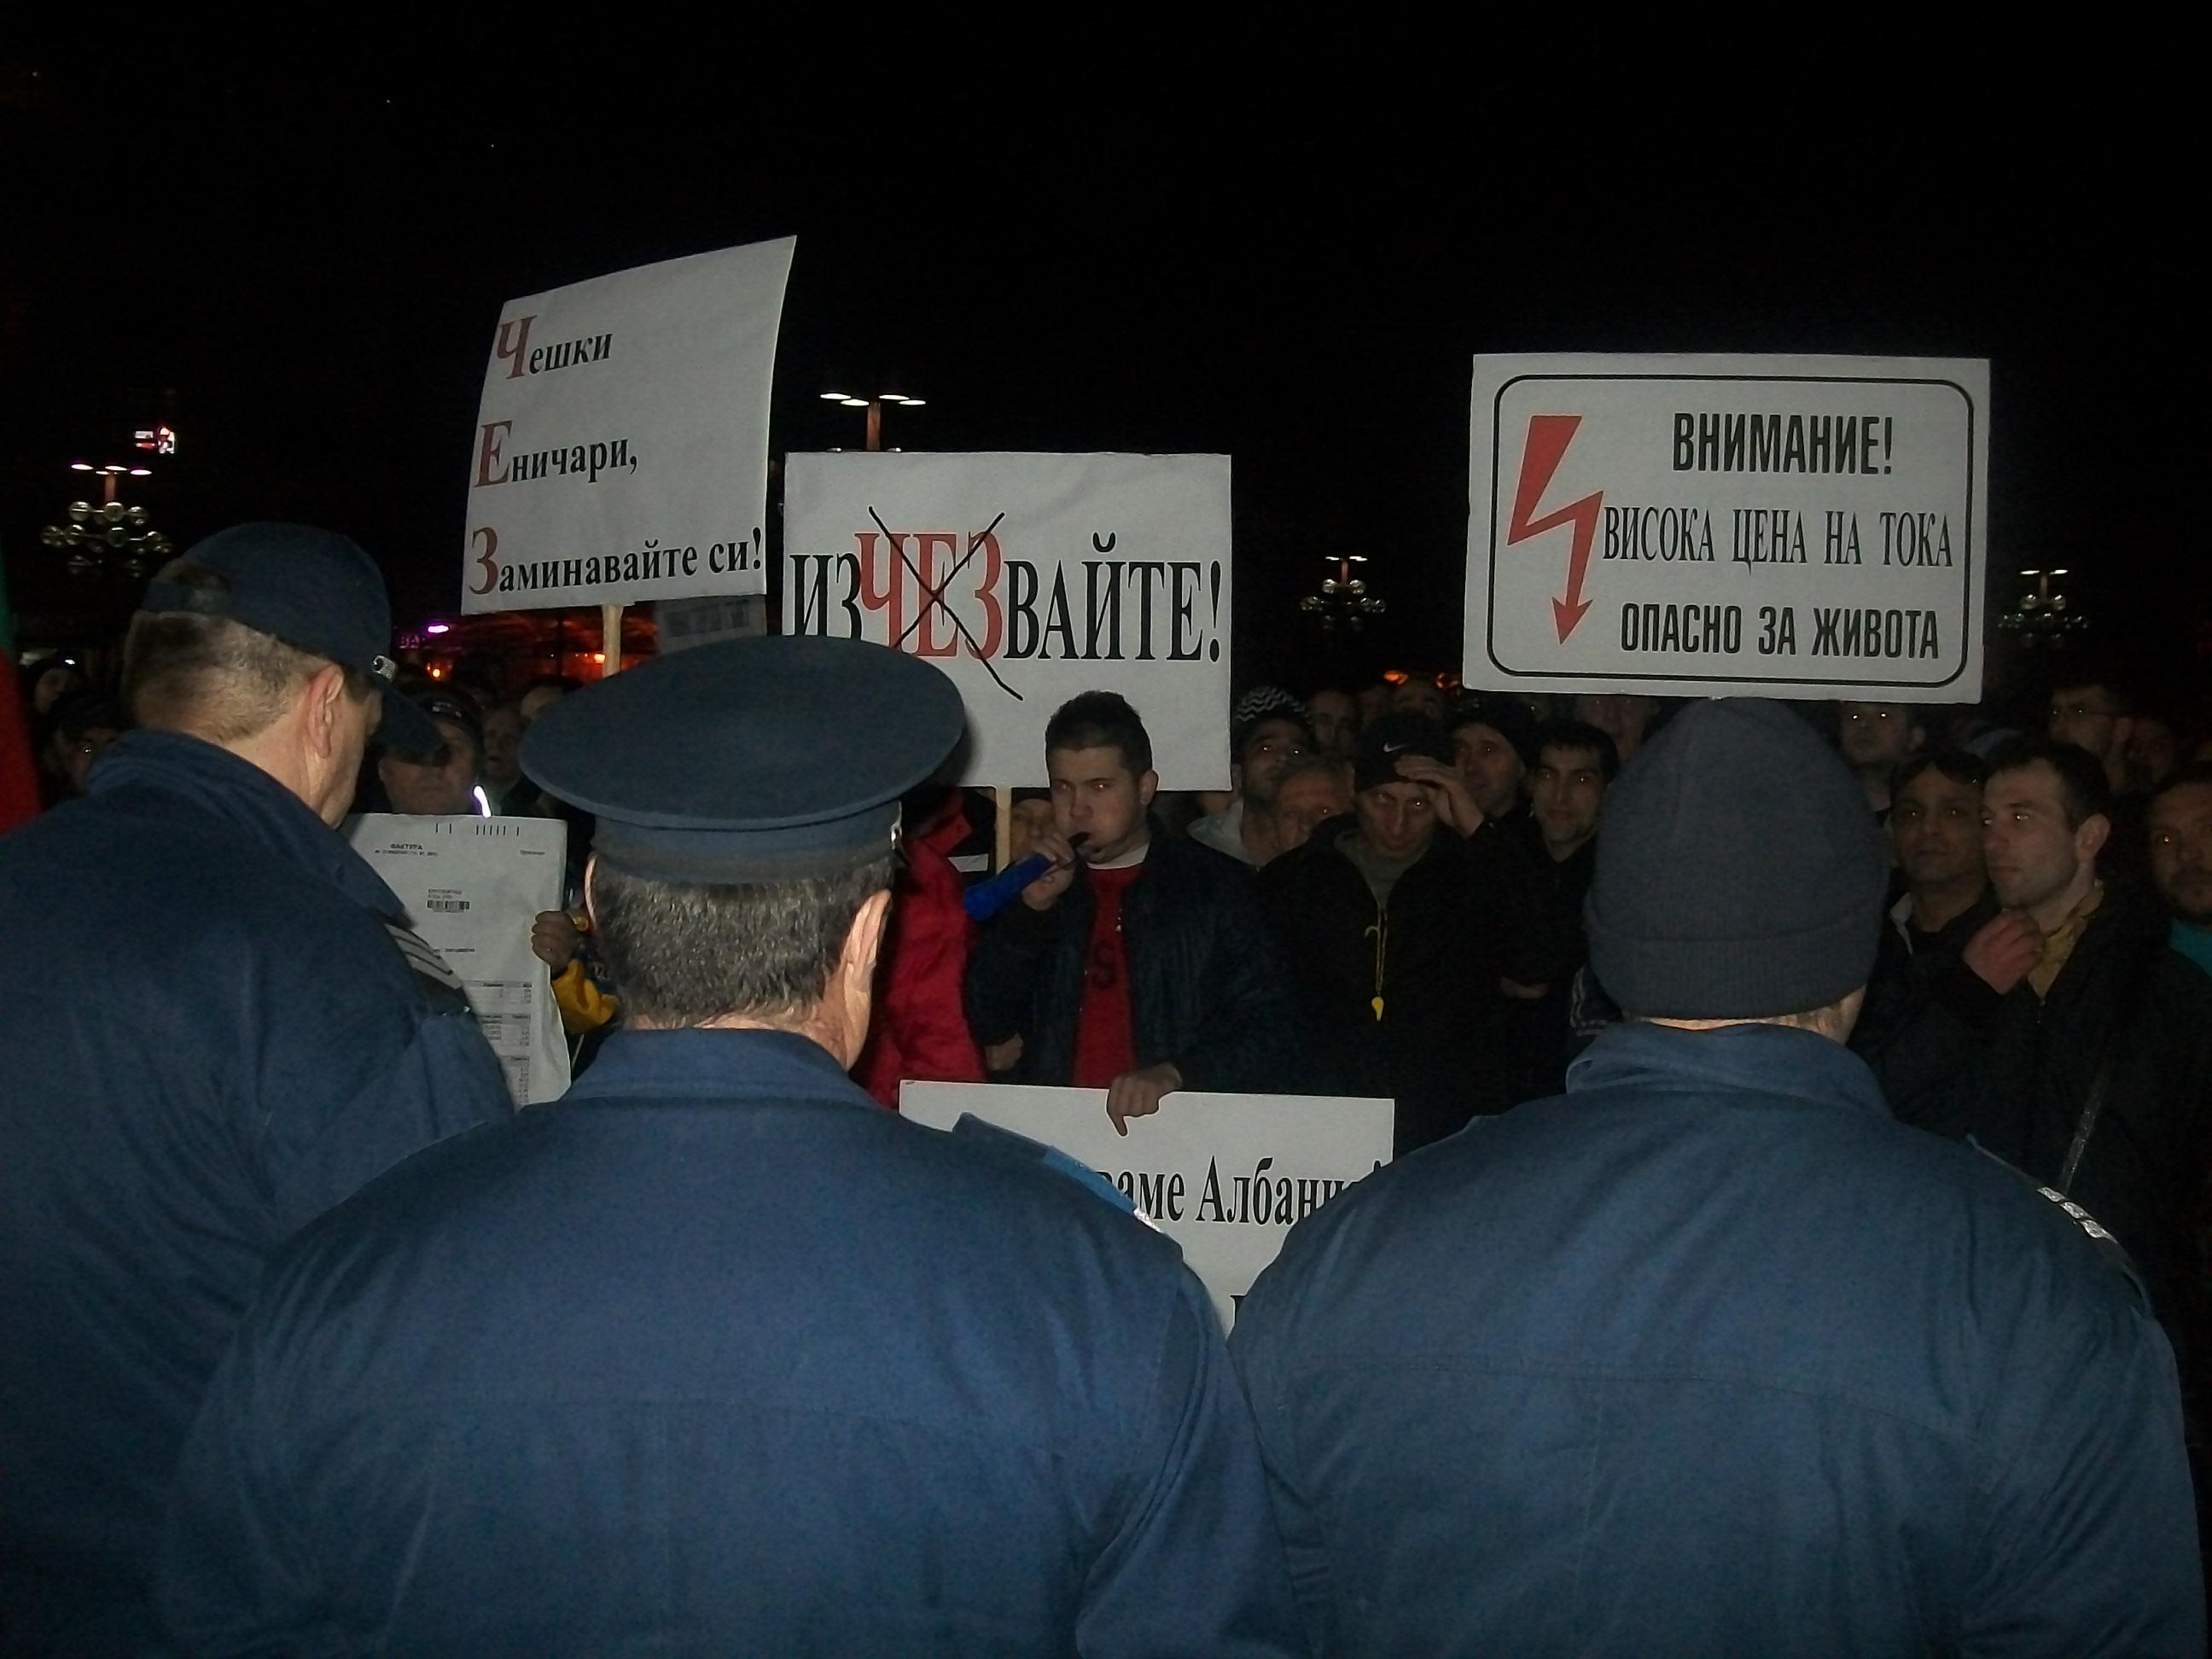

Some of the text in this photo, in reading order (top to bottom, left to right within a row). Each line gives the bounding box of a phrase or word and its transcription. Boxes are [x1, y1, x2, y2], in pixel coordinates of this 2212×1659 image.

[497, 315, 613, 380] Чешки
[474, 421, 637, 488] Еничари,
[1673, 413, 1893, 474] ВНИМАНИЕ!
[469, 527, 761, 595] Заминавайте си!
[1604, 507, 1953, 575] ВИСОКА ЦЕНА НА ТОКА
[1621, 603, 1939, 659] ОПАСНО ЗА ЖИВОТА
[1096, 1171, 1185, 1221] аме
